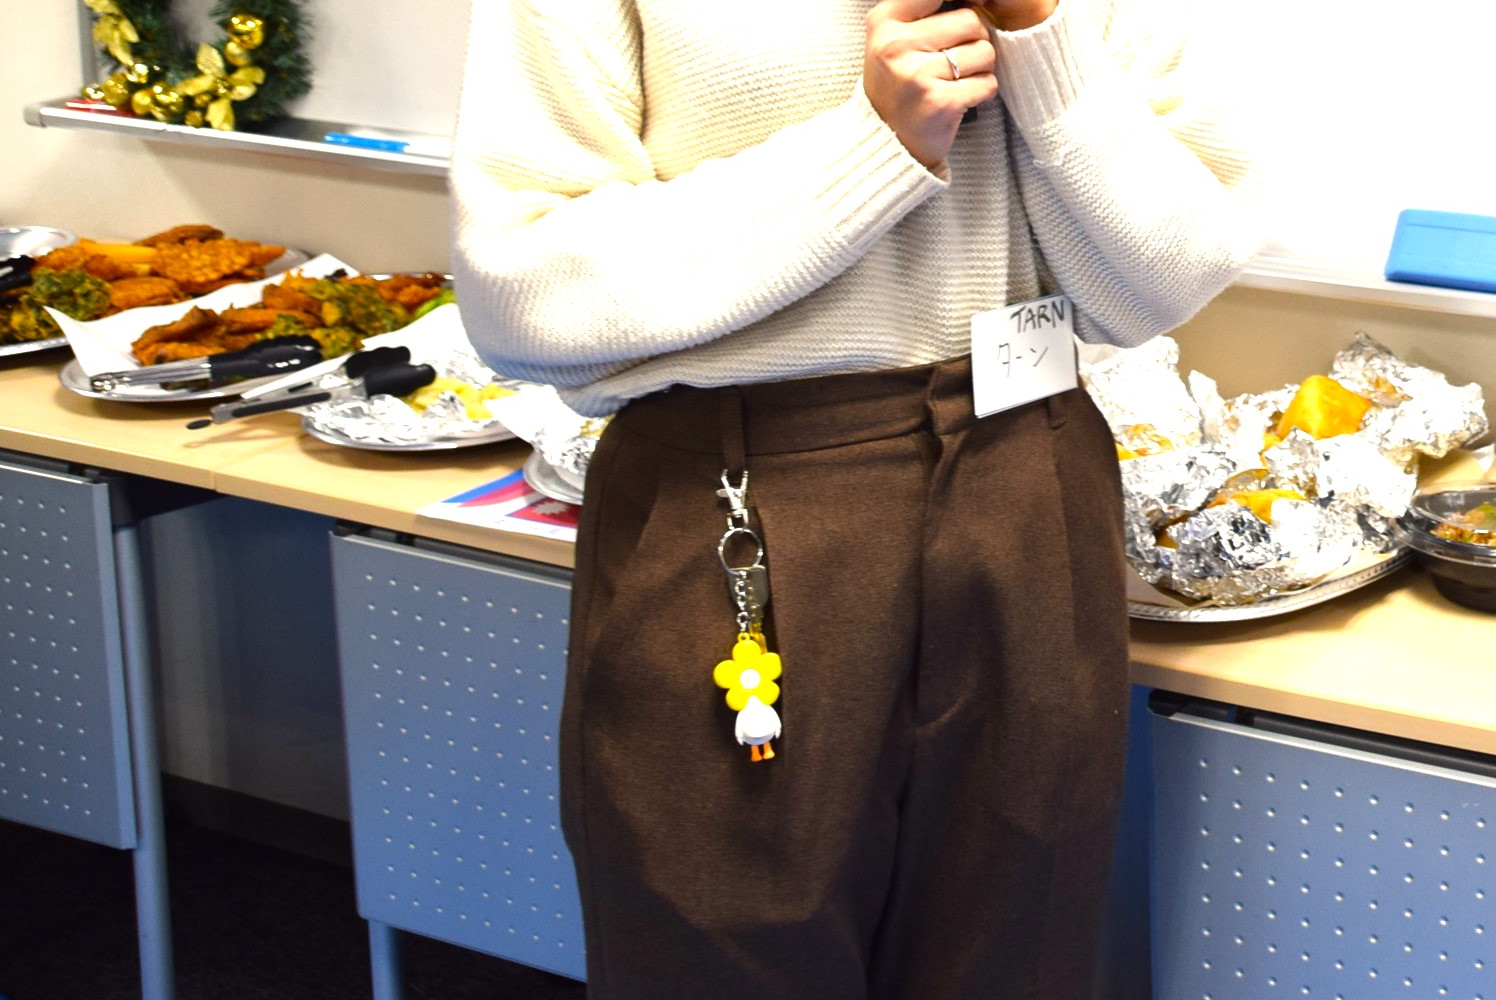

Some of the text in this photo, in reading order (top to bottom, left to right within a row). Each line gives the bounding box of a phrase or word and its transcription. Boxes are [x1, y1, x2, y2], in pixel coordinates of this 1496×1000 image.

[1010, 301, 1065, 333] TARN
[998, 342, 1049, 378] ターン
